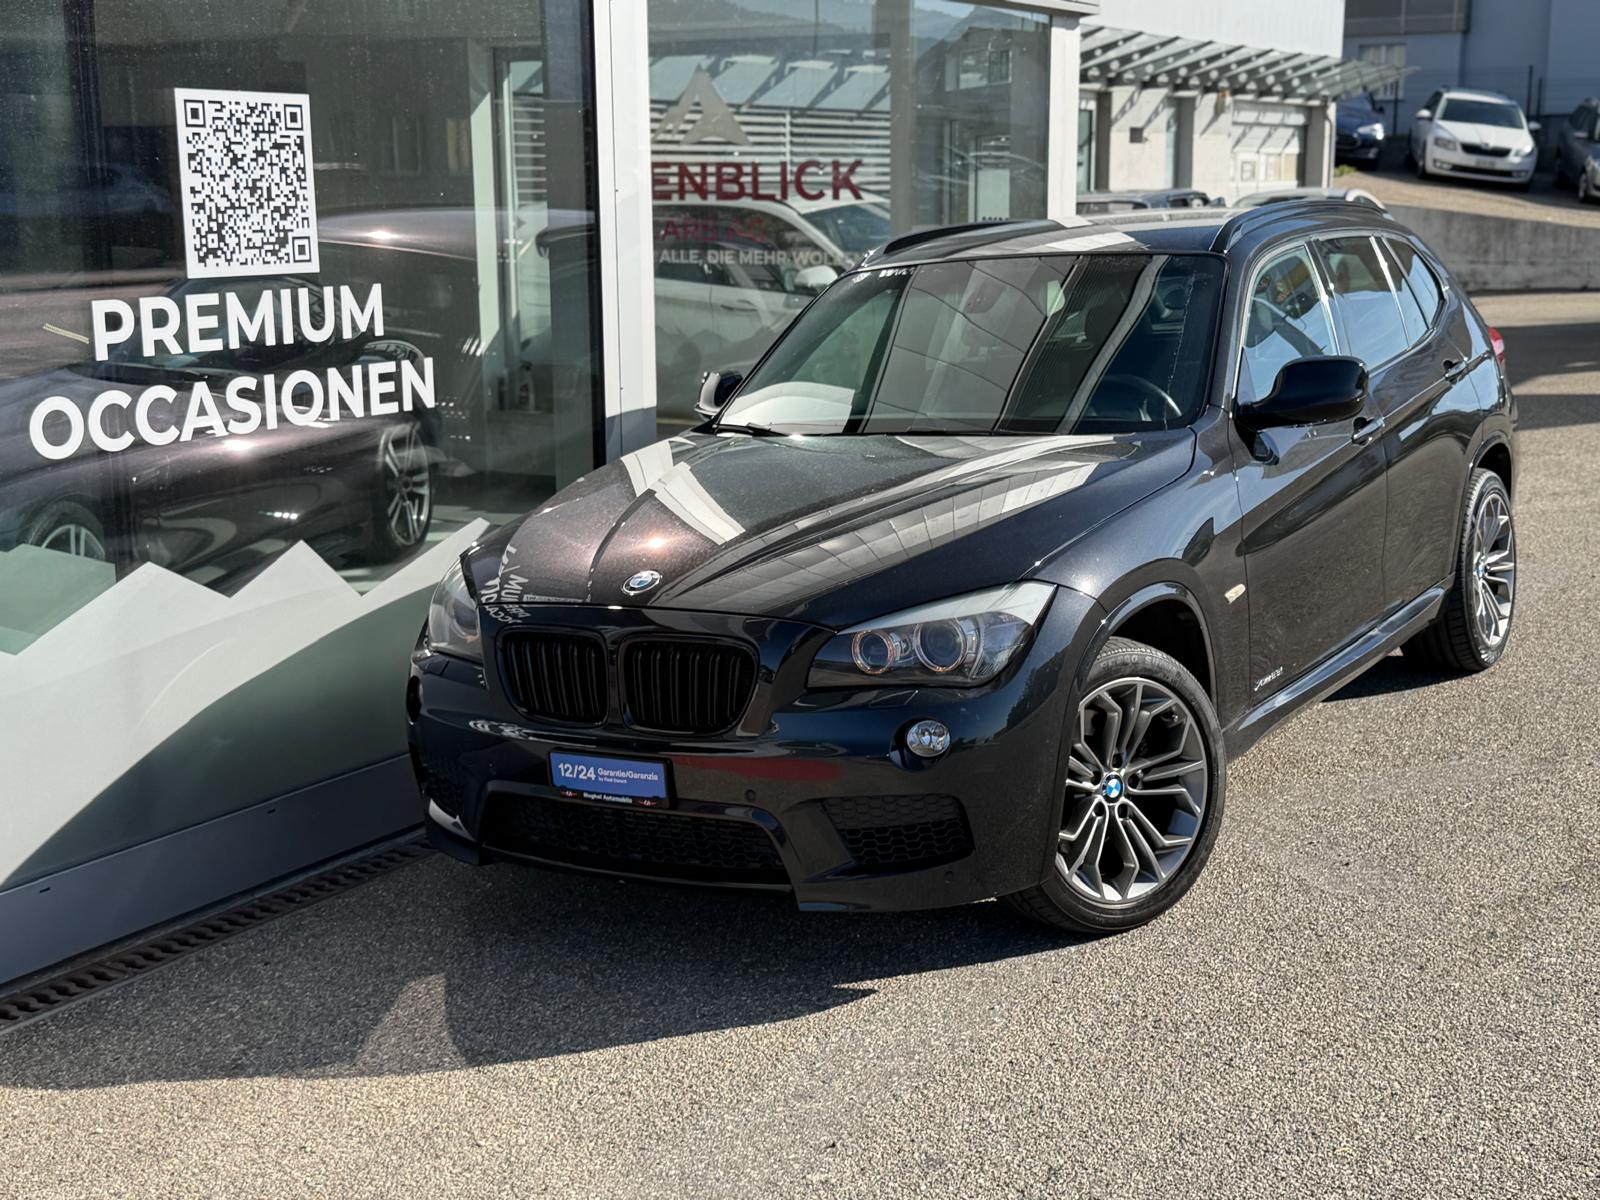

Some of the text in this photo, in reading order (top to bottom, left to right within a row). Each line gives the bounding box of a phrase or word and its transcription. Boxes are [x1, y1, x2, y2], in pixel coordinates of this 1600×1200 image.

[659, 250, 703, 267] ALLE,
[707, 250, 736, 264] DIE
[739, 251, 787, 265] MEHR
[91, 283, 385, 361] PREMIUM
[29, 357, 436, 460] OCCASIONEN
[558, 762, 596, 780] 12/24
